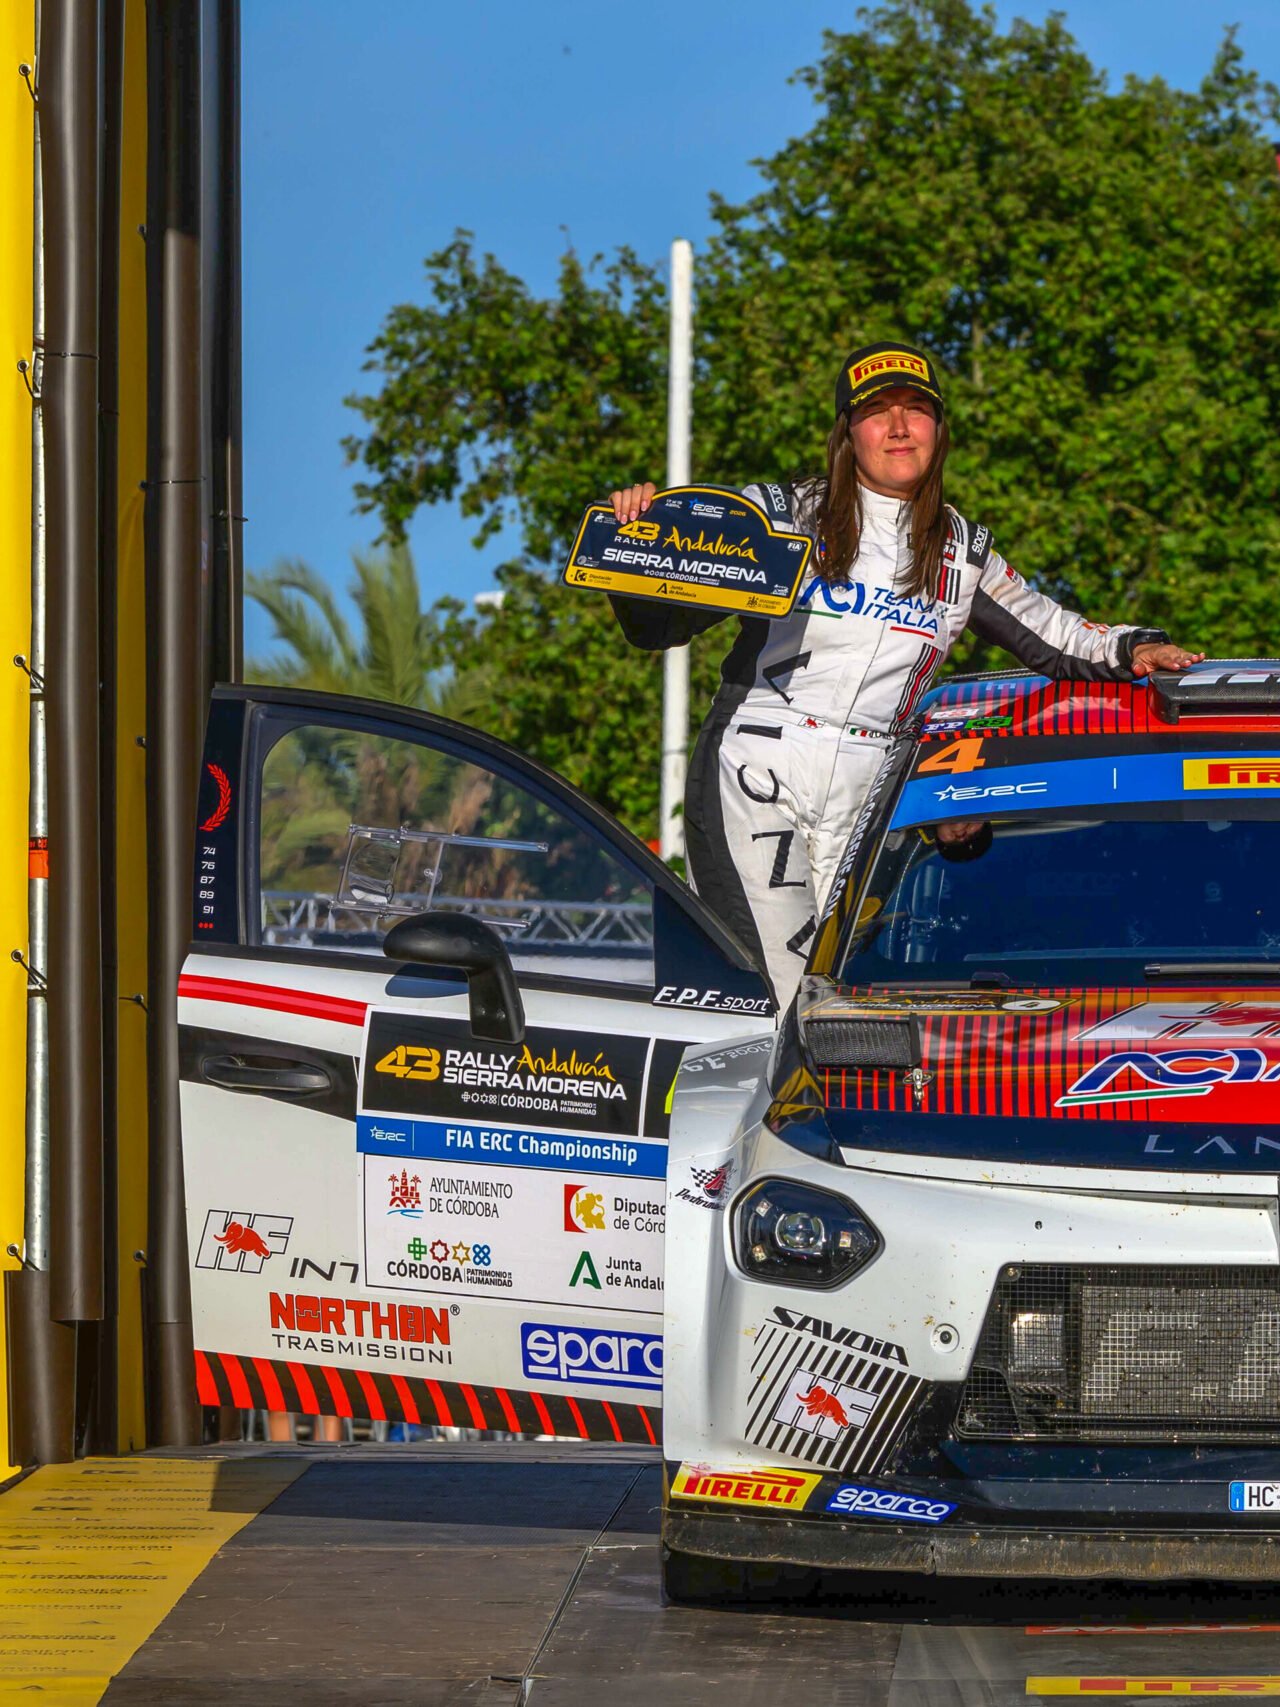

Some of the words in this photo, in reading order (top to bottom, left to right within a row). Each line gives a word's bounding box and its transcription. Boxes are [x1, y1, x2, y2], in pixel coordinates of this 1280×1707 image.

[854, 353, 924, 381] PIRELLI
[617, 520, 661, 540] 43
[614, 535, 656, 548] RALLY
[662, 525, 759, 563] Andalucía
[787, 541, 801, 551] FIA
[602, 548, 675, 572] SIERRA
[678, 558, 767, 585] MORENA
[665, 571, 699, 583] CÓRDOBA
[863, 602, 938, 633] ITALIA
[917, 738, 986, 774] 4
[951, 781, 1047, 801] ERC
[202, 847, 216, 856] 74
[200, 862, 216, 870] 76
[199, 876, 215, 885] 87
[199, 891, 215, 899] 89
[202, 906, 215, 914] 91
[374, 1045, 441, 1081] 43
[444, 1050, 514, 1072] RALLY
[515, 1043, 617, 1082] Andalucía
[443, 1068, 525, 1089] SIERRA
[526, 1076, 628, 1102] MORENA
[500, 1093, 559, 1112] CÓRDOBA
[559, 1106, 597, 1116] HUMANIDAD
[560, 1100, 593, 1109] PATRIMONIO
[374, 1130, 406, 1143] ERC
[446, 1129, 474, 1149] FIA
[479, 1132, 513, 1152] ERC
[518, 1135, 638, 1166] Championship
[430, 1177, 513, 1199] AYUNTAMIENTO
[430, 1197, 442, 1213] DE
[446, 1197, 499, 1218] CÓRDOBA
[613, 1197, 665, 1216] Diputac
[613, 1216, 630, 1230] de
[634, 1216, 665, 1234] Córd
[387, 1258, 463, 1283] CÓRDOBA
[466, 1268, 508, 1280] PATRIMONIO
[605, 1256, 642, 1272] Junta
[466, 1275, 513, 1288] HUMANIDAD
[606, 1273, 621, 1287] de
[271, 1333, 453, 1365] TRASMISSIONI
[526, 1329, 664, 1380] sparc
[685, 1464, 806, 1504] PIRELLI
[830, 1485, 950, 1520] sparco
[1248, 1486, 1275, 1507] HC
